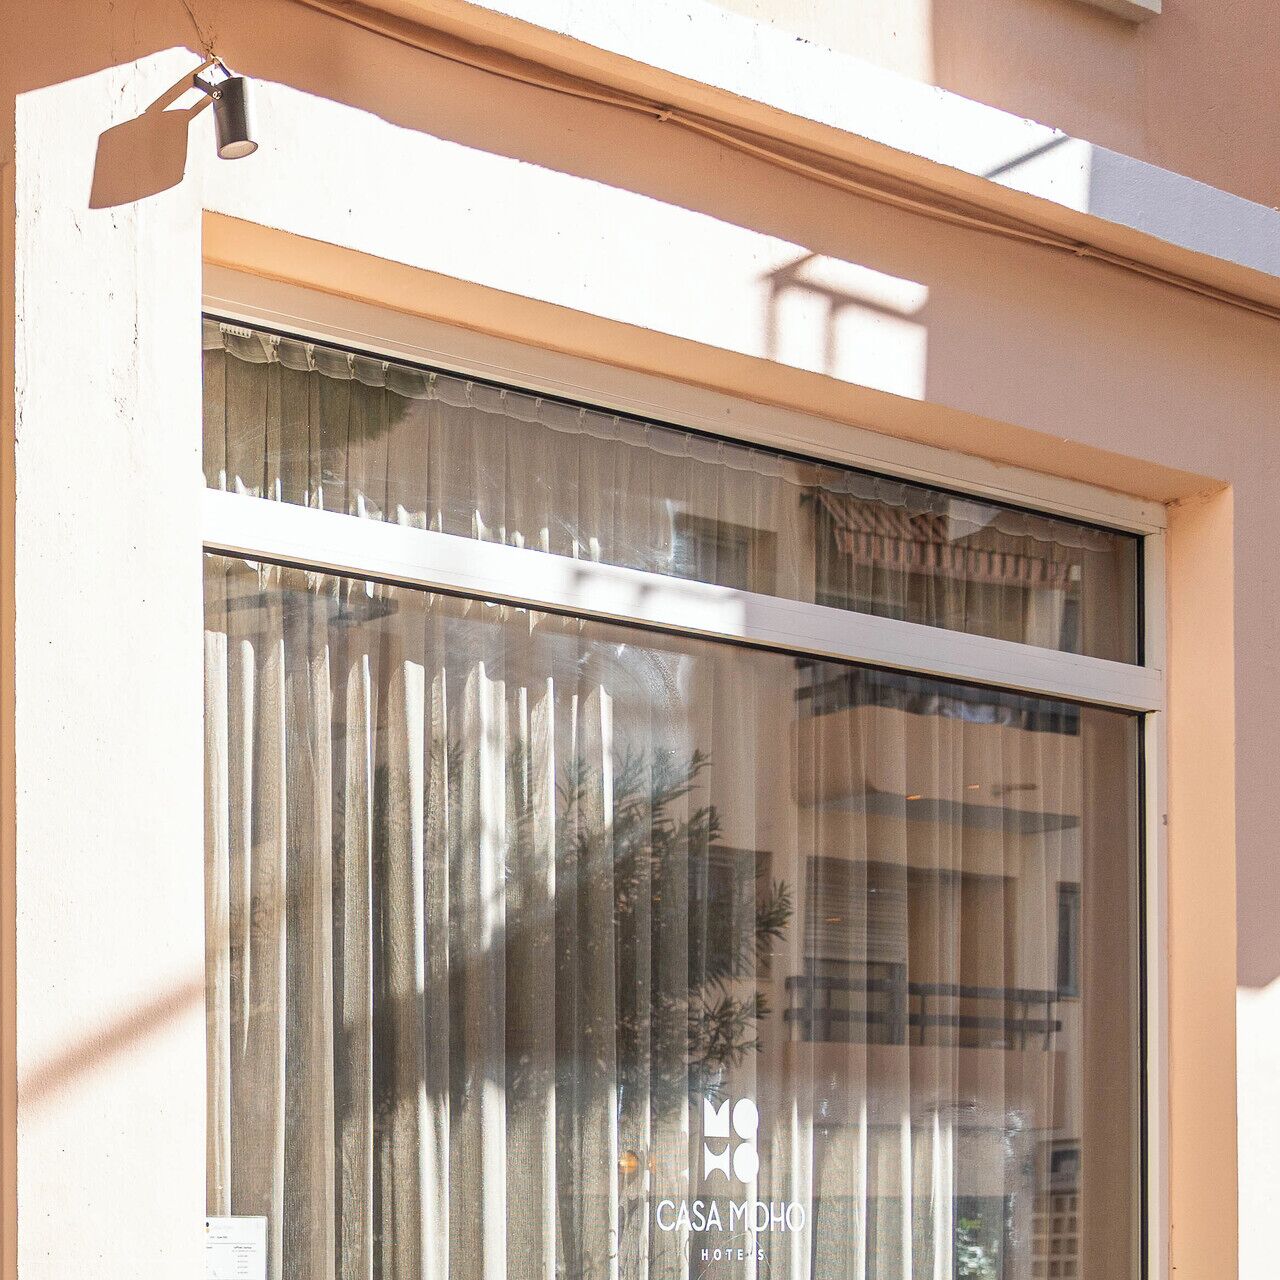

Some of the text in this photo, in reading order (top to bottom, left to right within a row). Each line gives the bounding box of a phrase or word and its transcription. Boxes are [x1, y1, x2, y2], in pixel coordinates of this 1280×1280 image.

[656, 1200, 806, 1232] CASA MOHO
[701, 1248, 765, 1261] HOTES
